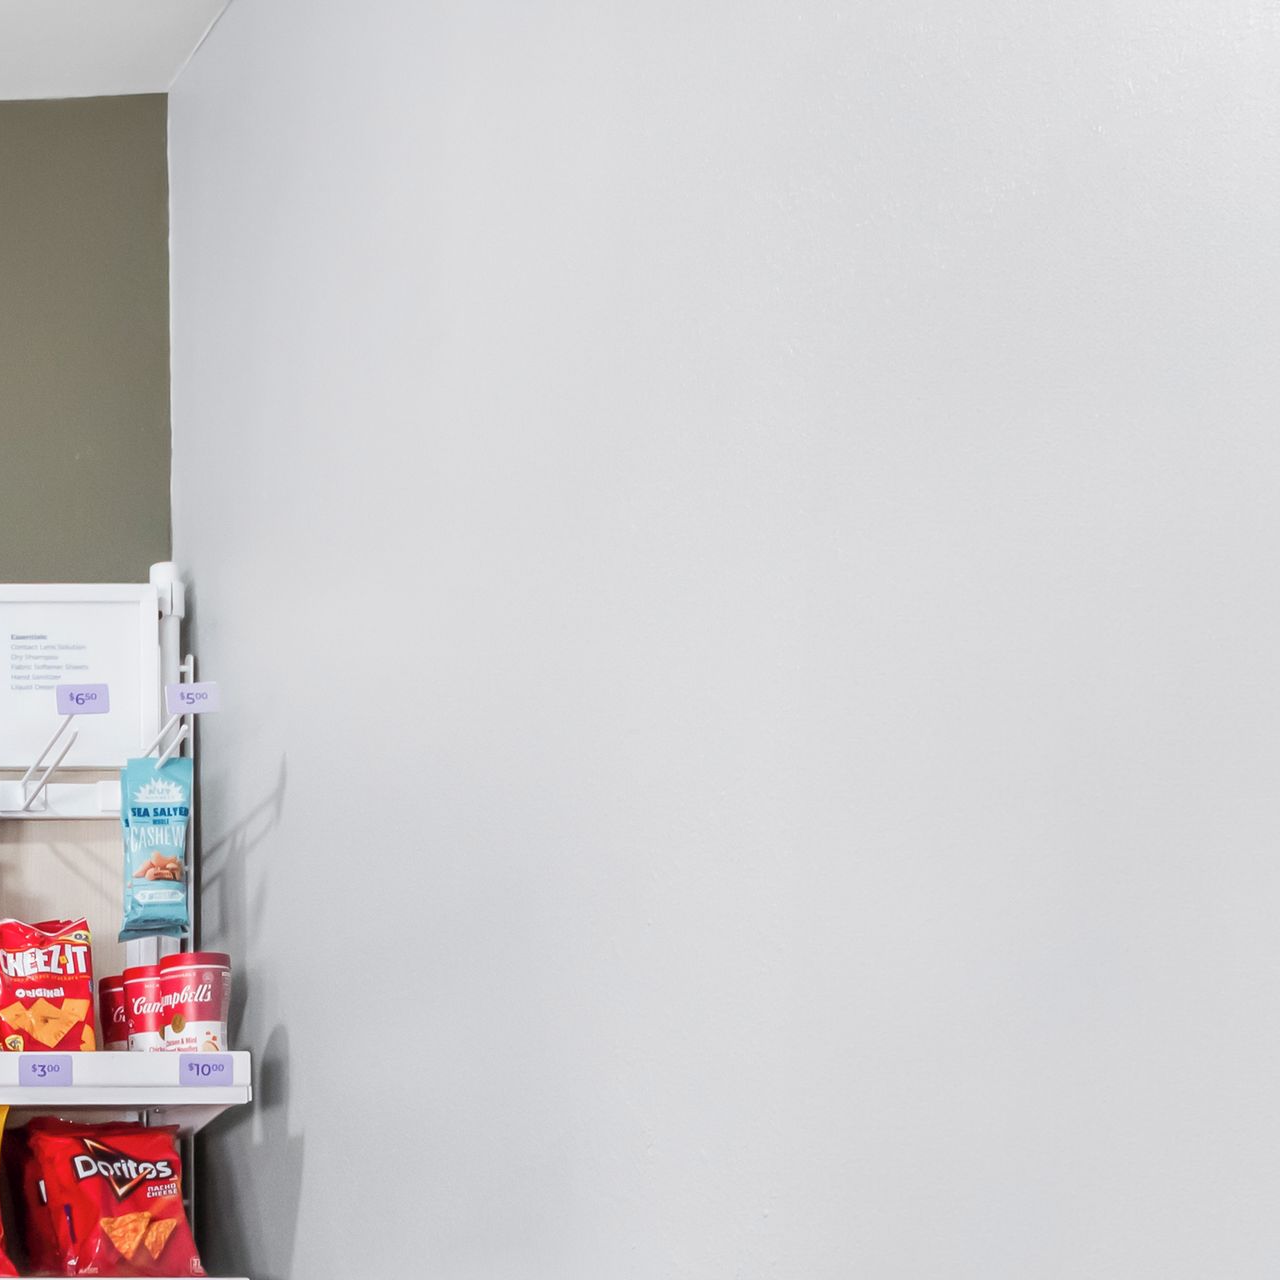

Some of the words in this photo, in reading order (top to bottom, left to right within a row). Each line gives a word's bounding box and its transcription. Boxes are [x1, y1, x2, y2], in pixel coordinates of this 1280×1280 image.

[131, 808, 150, 817] SEA
[152, 807, 189, 817] SALTED
[74, 1155, 172, 1180] Doritos
[147, 1183, 177, 1191] NACHO
[147, 1189, 178, 1198] CHEESE
